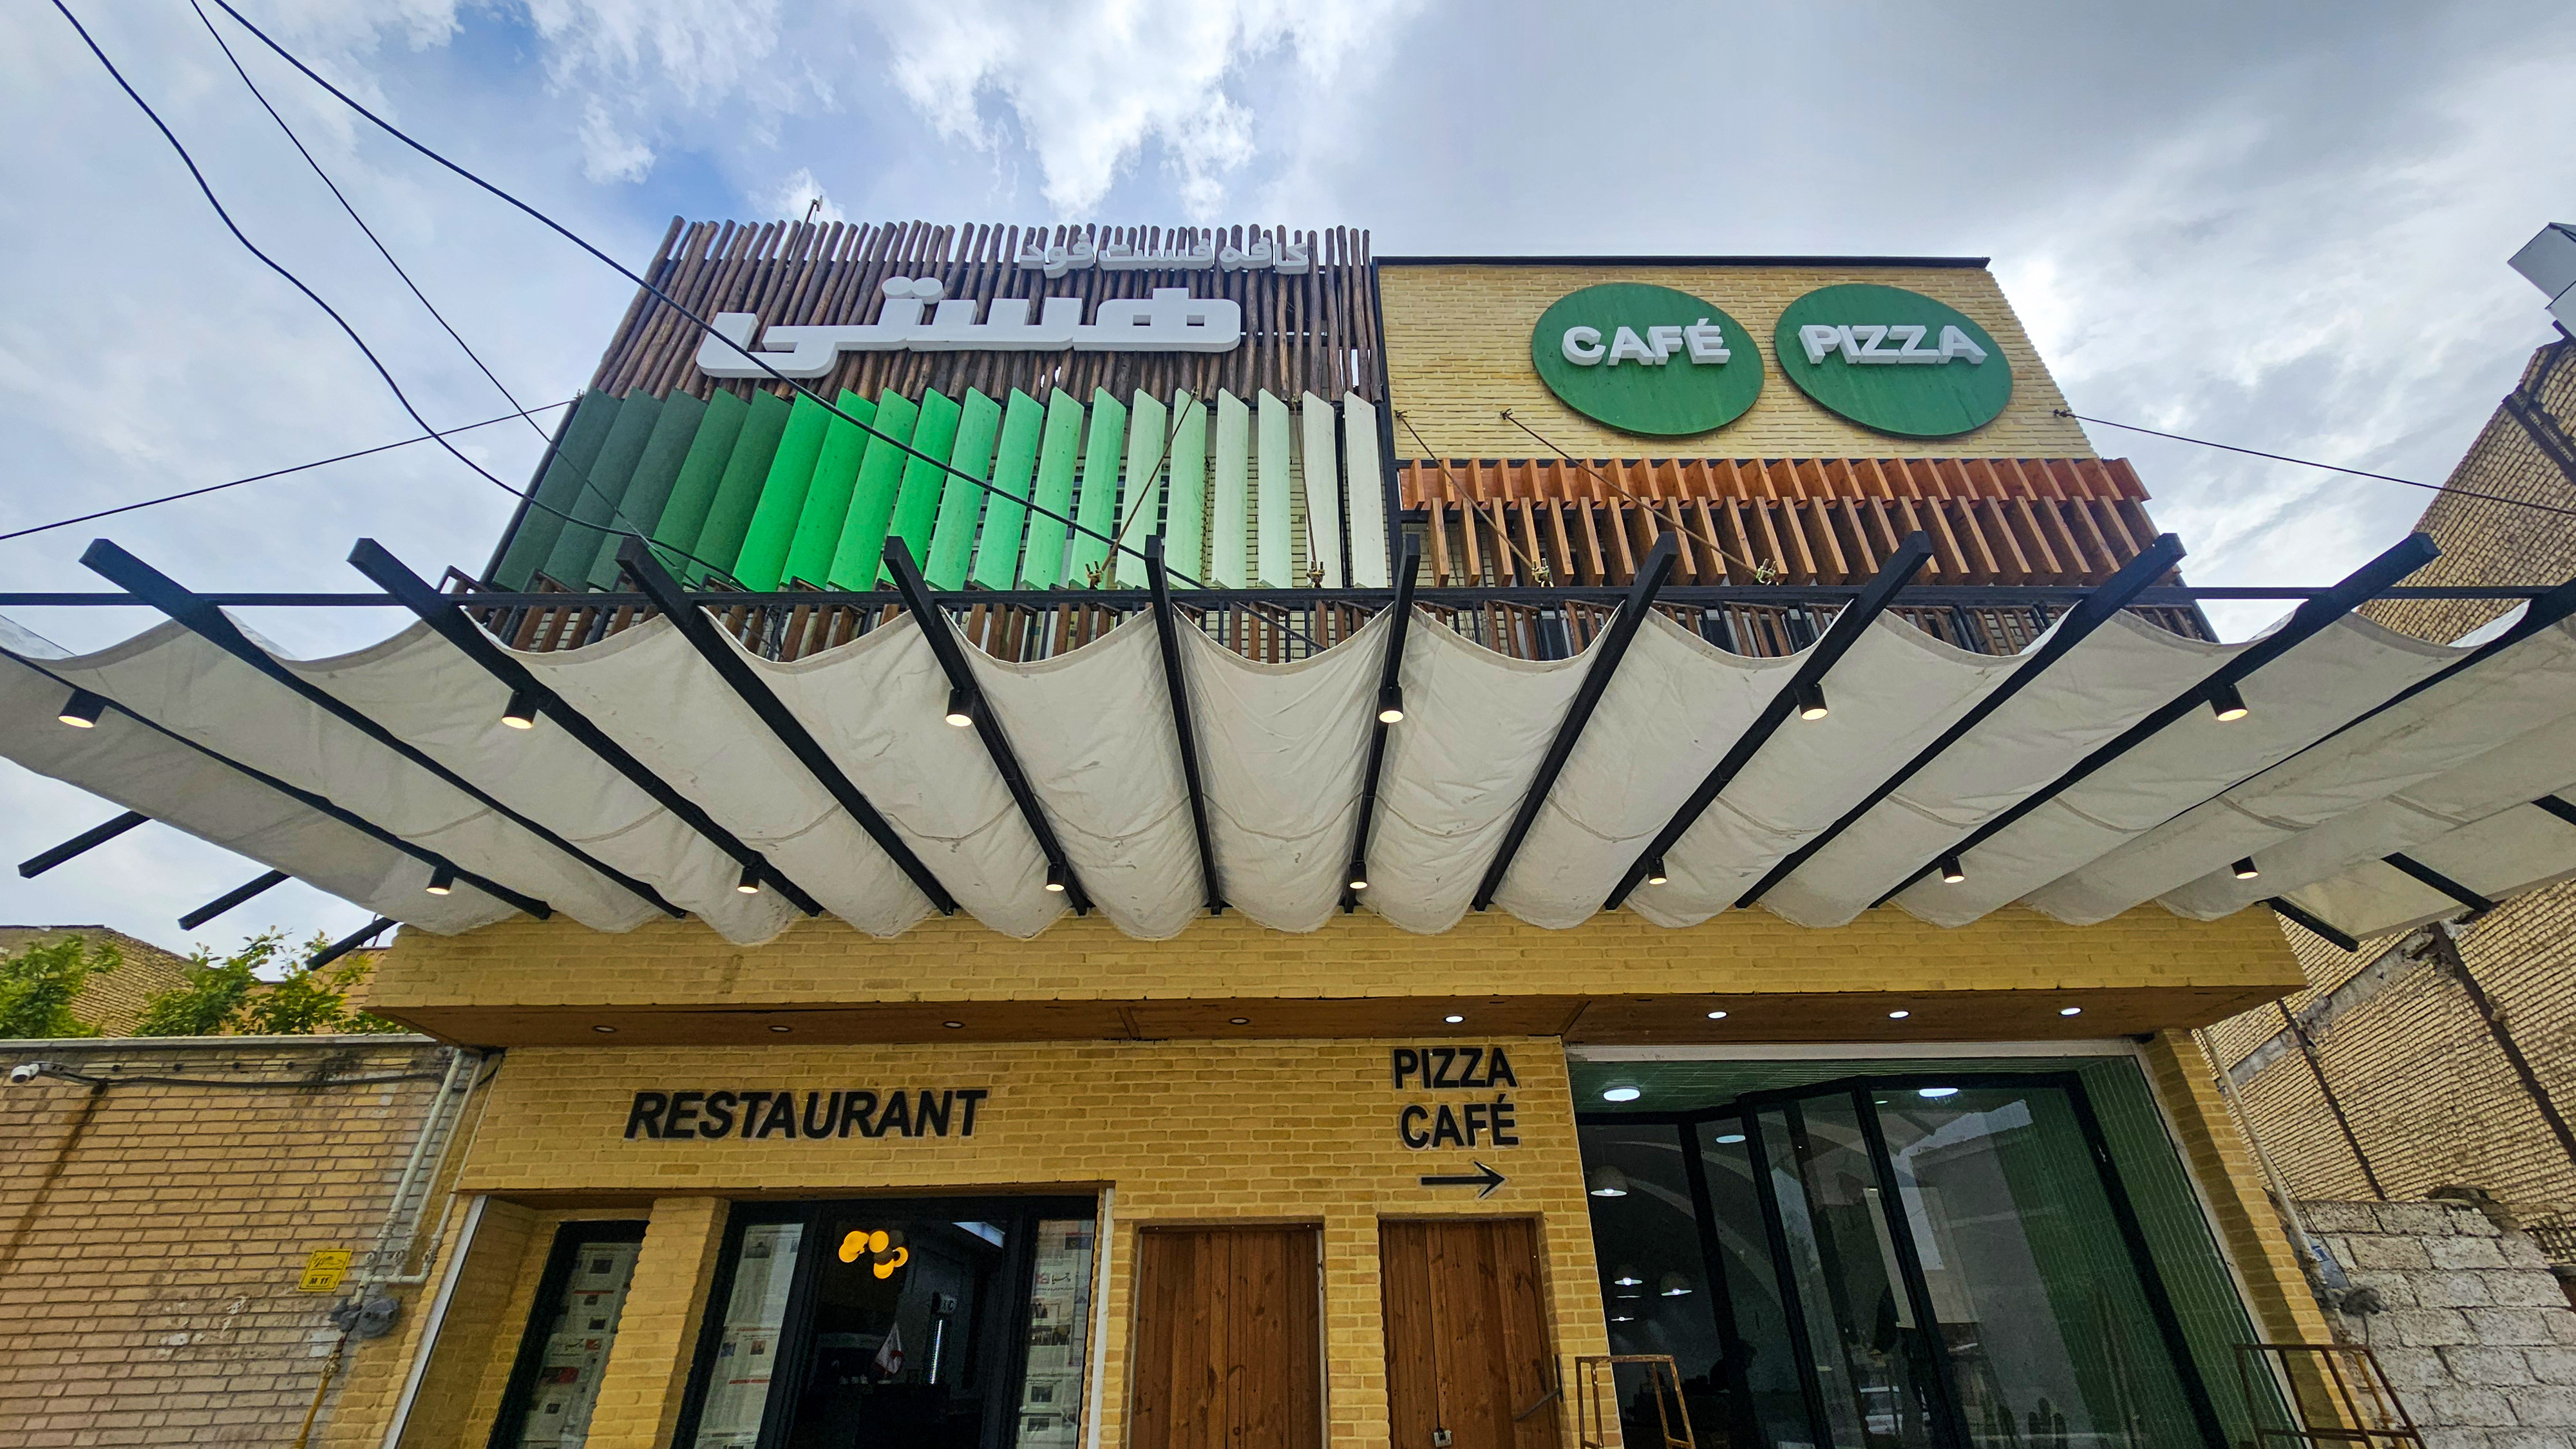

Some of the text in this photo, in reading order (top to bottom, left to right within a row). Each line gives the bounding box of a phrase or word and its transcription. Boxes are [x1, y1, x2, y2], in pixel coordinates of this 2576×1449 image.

[1019, 232, 1309, 279] کافه فست فود
[696, 276, 1242, 379] هستی
[1562, 317, 1731, 366] CAFÉ
[1798, 325, 1988, 365] PIZZA
[1393, 1047, 1519, 1090] PIZZA
[623, 1090, 988, 1139] RESTAURANT
[1401, 1093, 1519, 1149] CAFÉ
